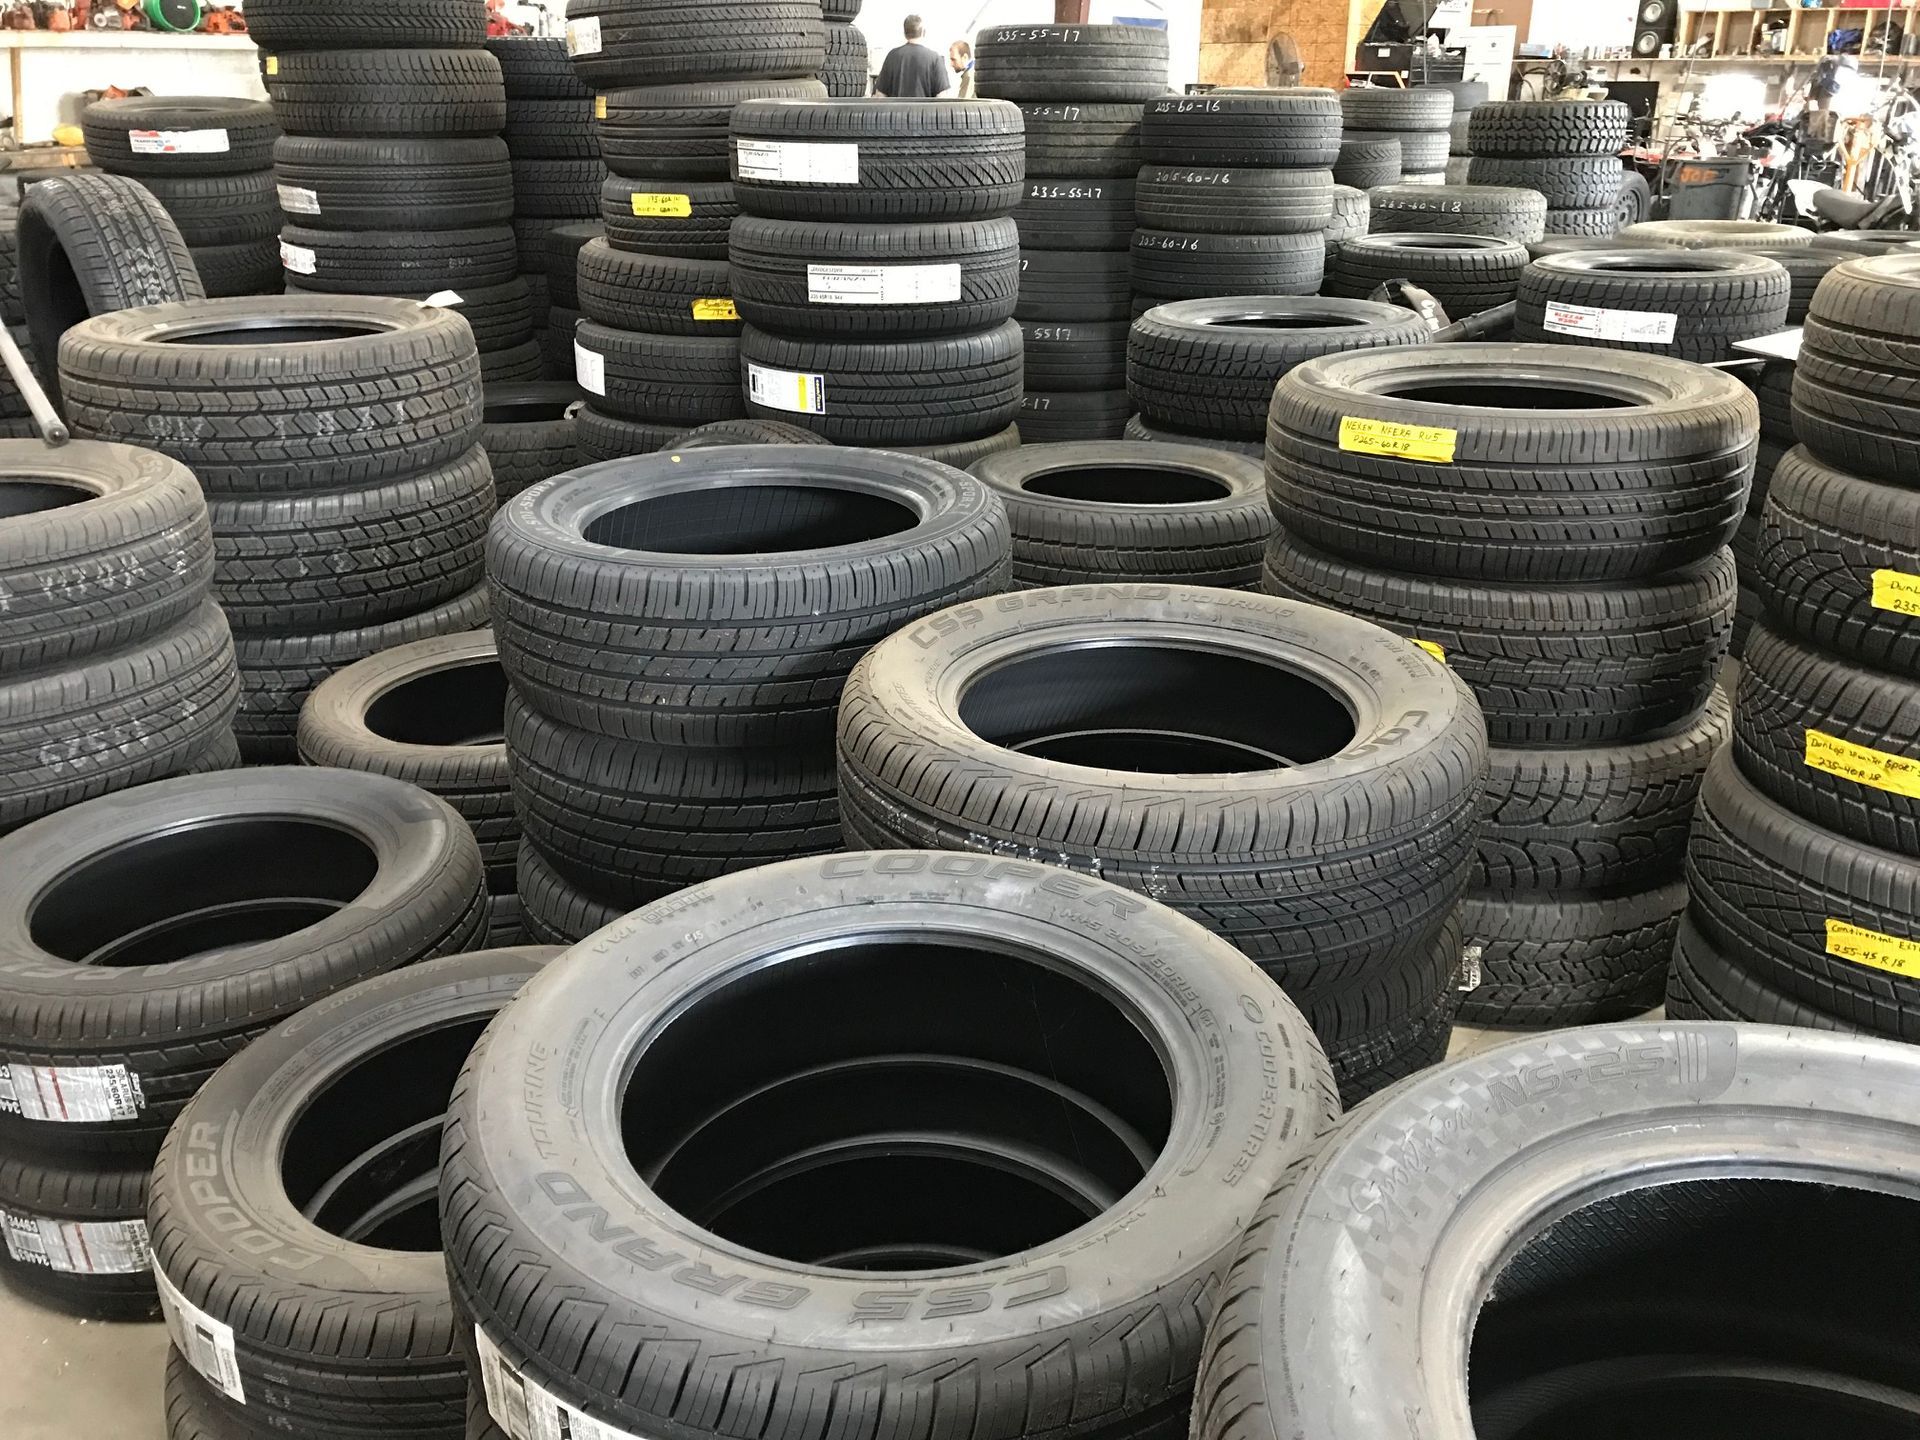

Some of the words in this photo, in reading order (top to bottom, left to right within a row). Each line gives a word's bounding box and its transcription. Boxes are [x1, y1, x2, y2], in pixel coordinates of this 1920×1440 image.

[997, 29, 1080, 42] 235-55-17
[1020, 106, 1080, 120] -55-17
[1155, 100, 1220, 113] 205-60-16
[1156, 172, 1230, 184] 205-60-16
[1031, 185, 1102, 198] 235-55-17
[1380, 200, 1462, 212] 265-60-18
[1139, 235, 1199, 250] 205-60-16
[1345, 420, 1373, 431] NEXEN
[996, 584, 1172, 613] GRAND
[1180, 591, 1296, 619] TOURING
[820, 854, 1146, 920] COOPER
[1486, 1046, 1665, 1116] NS-25
[523, 1040, 560, 1160] TOURING
[186, 1121, 325, 1270] COOPER
[535, 1172, 813, 1310] GRAND
